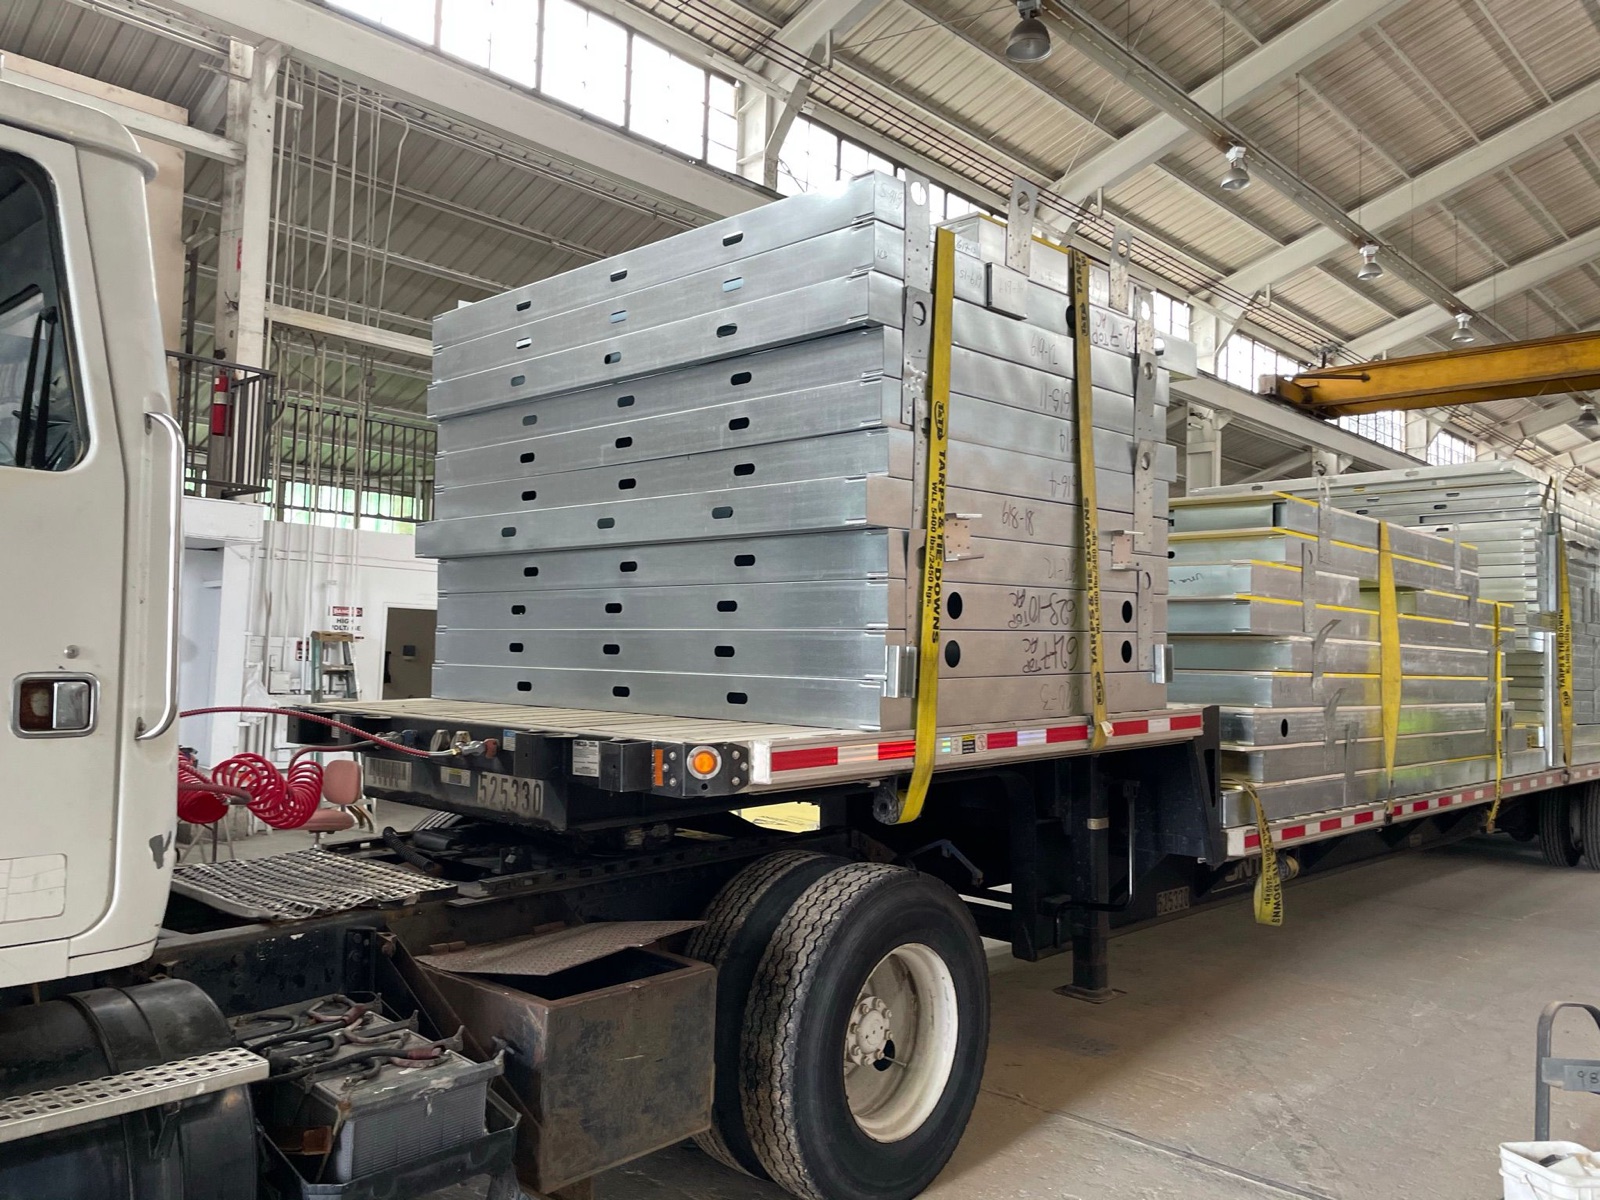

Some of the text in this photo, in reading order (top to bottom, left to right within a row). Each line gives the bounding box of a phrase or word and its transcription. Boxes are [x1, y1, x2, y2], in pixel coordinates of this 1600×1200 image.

[930, 508, 938, 533] 5400
[932, 450, 946, 643] TARPS & TIE-DOWNS
[1083, 497, 1094, 590] TIE-DOWNS
[1089, 609, 1097, 663] TARPS
[479, 774, 542, 816] 525330
